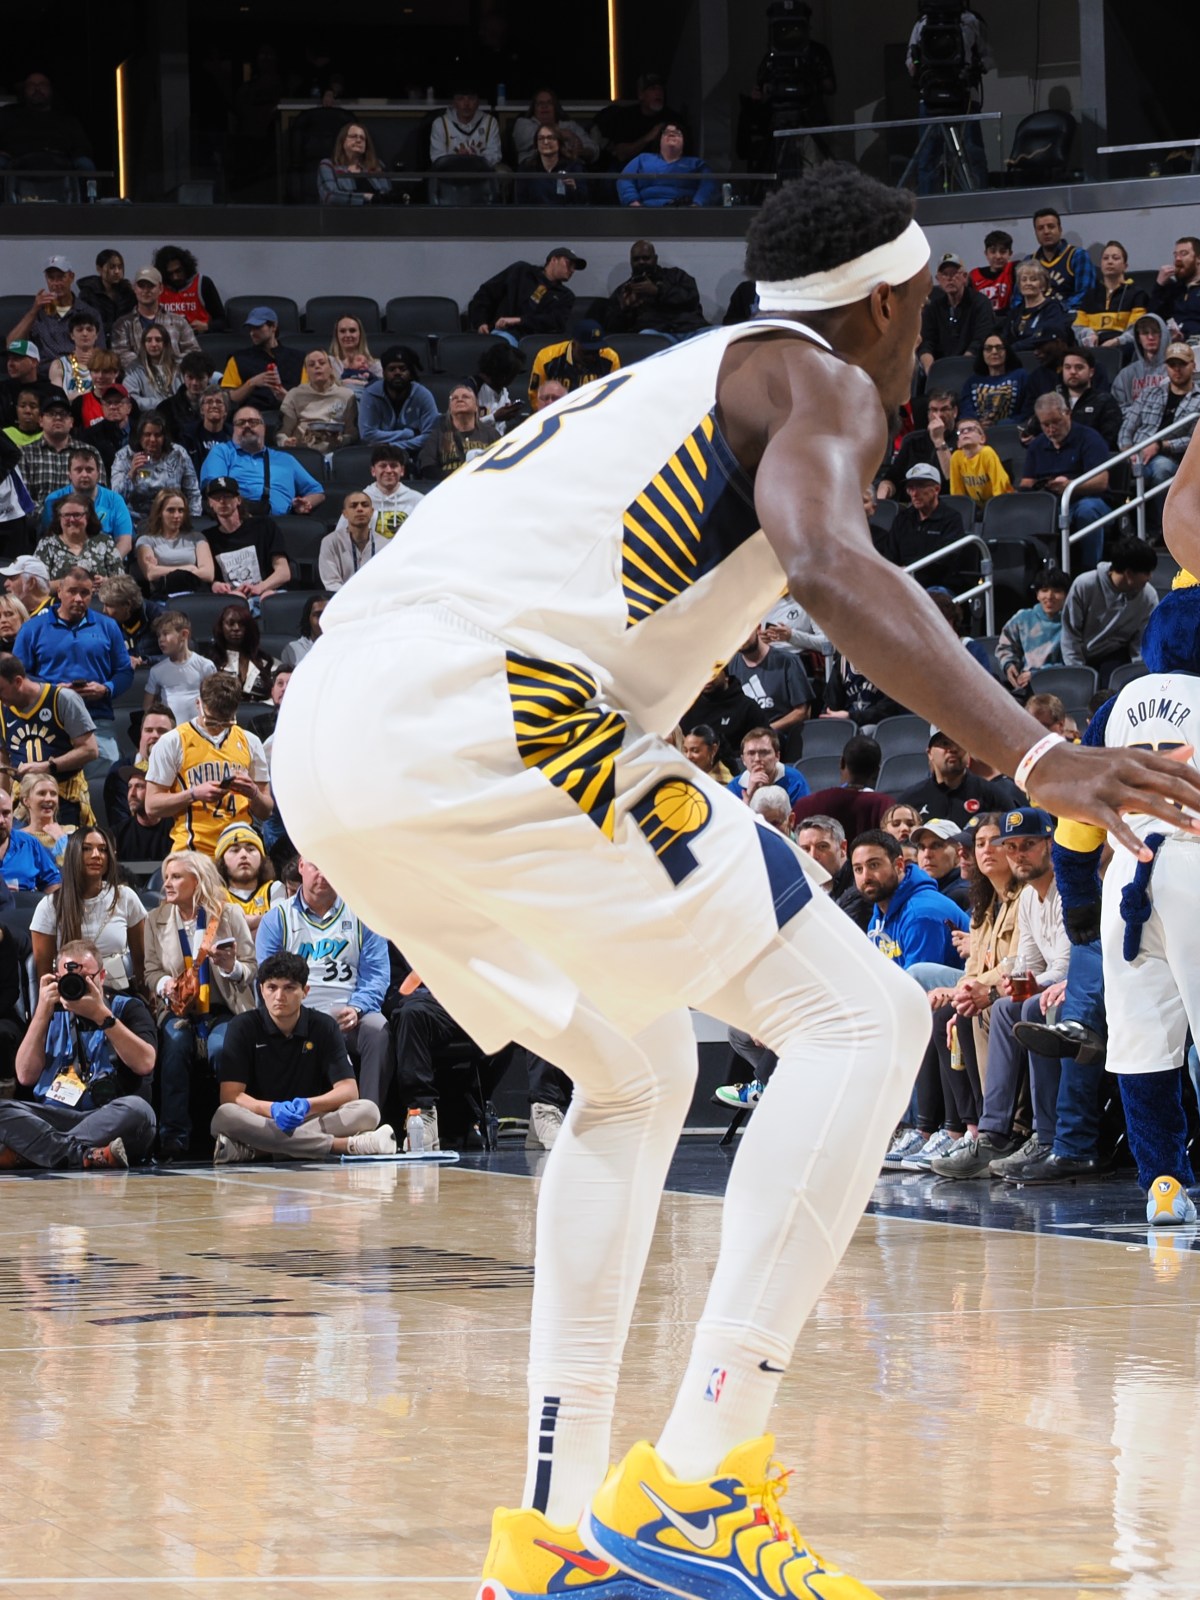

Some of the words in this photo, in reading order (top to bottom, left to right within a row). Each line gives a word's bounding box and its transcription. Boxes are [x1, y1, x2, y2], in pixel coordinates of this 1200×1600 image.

[1127, 698, 1191, 728] BOOMER
[10, 723, 56, 751] INDIANA
[26, 738, 43, 763] 11
[187, 761, 245, 786] INDIA
[297, 938, 350, 961] INDY
[322, 960, 353, 982] 33
